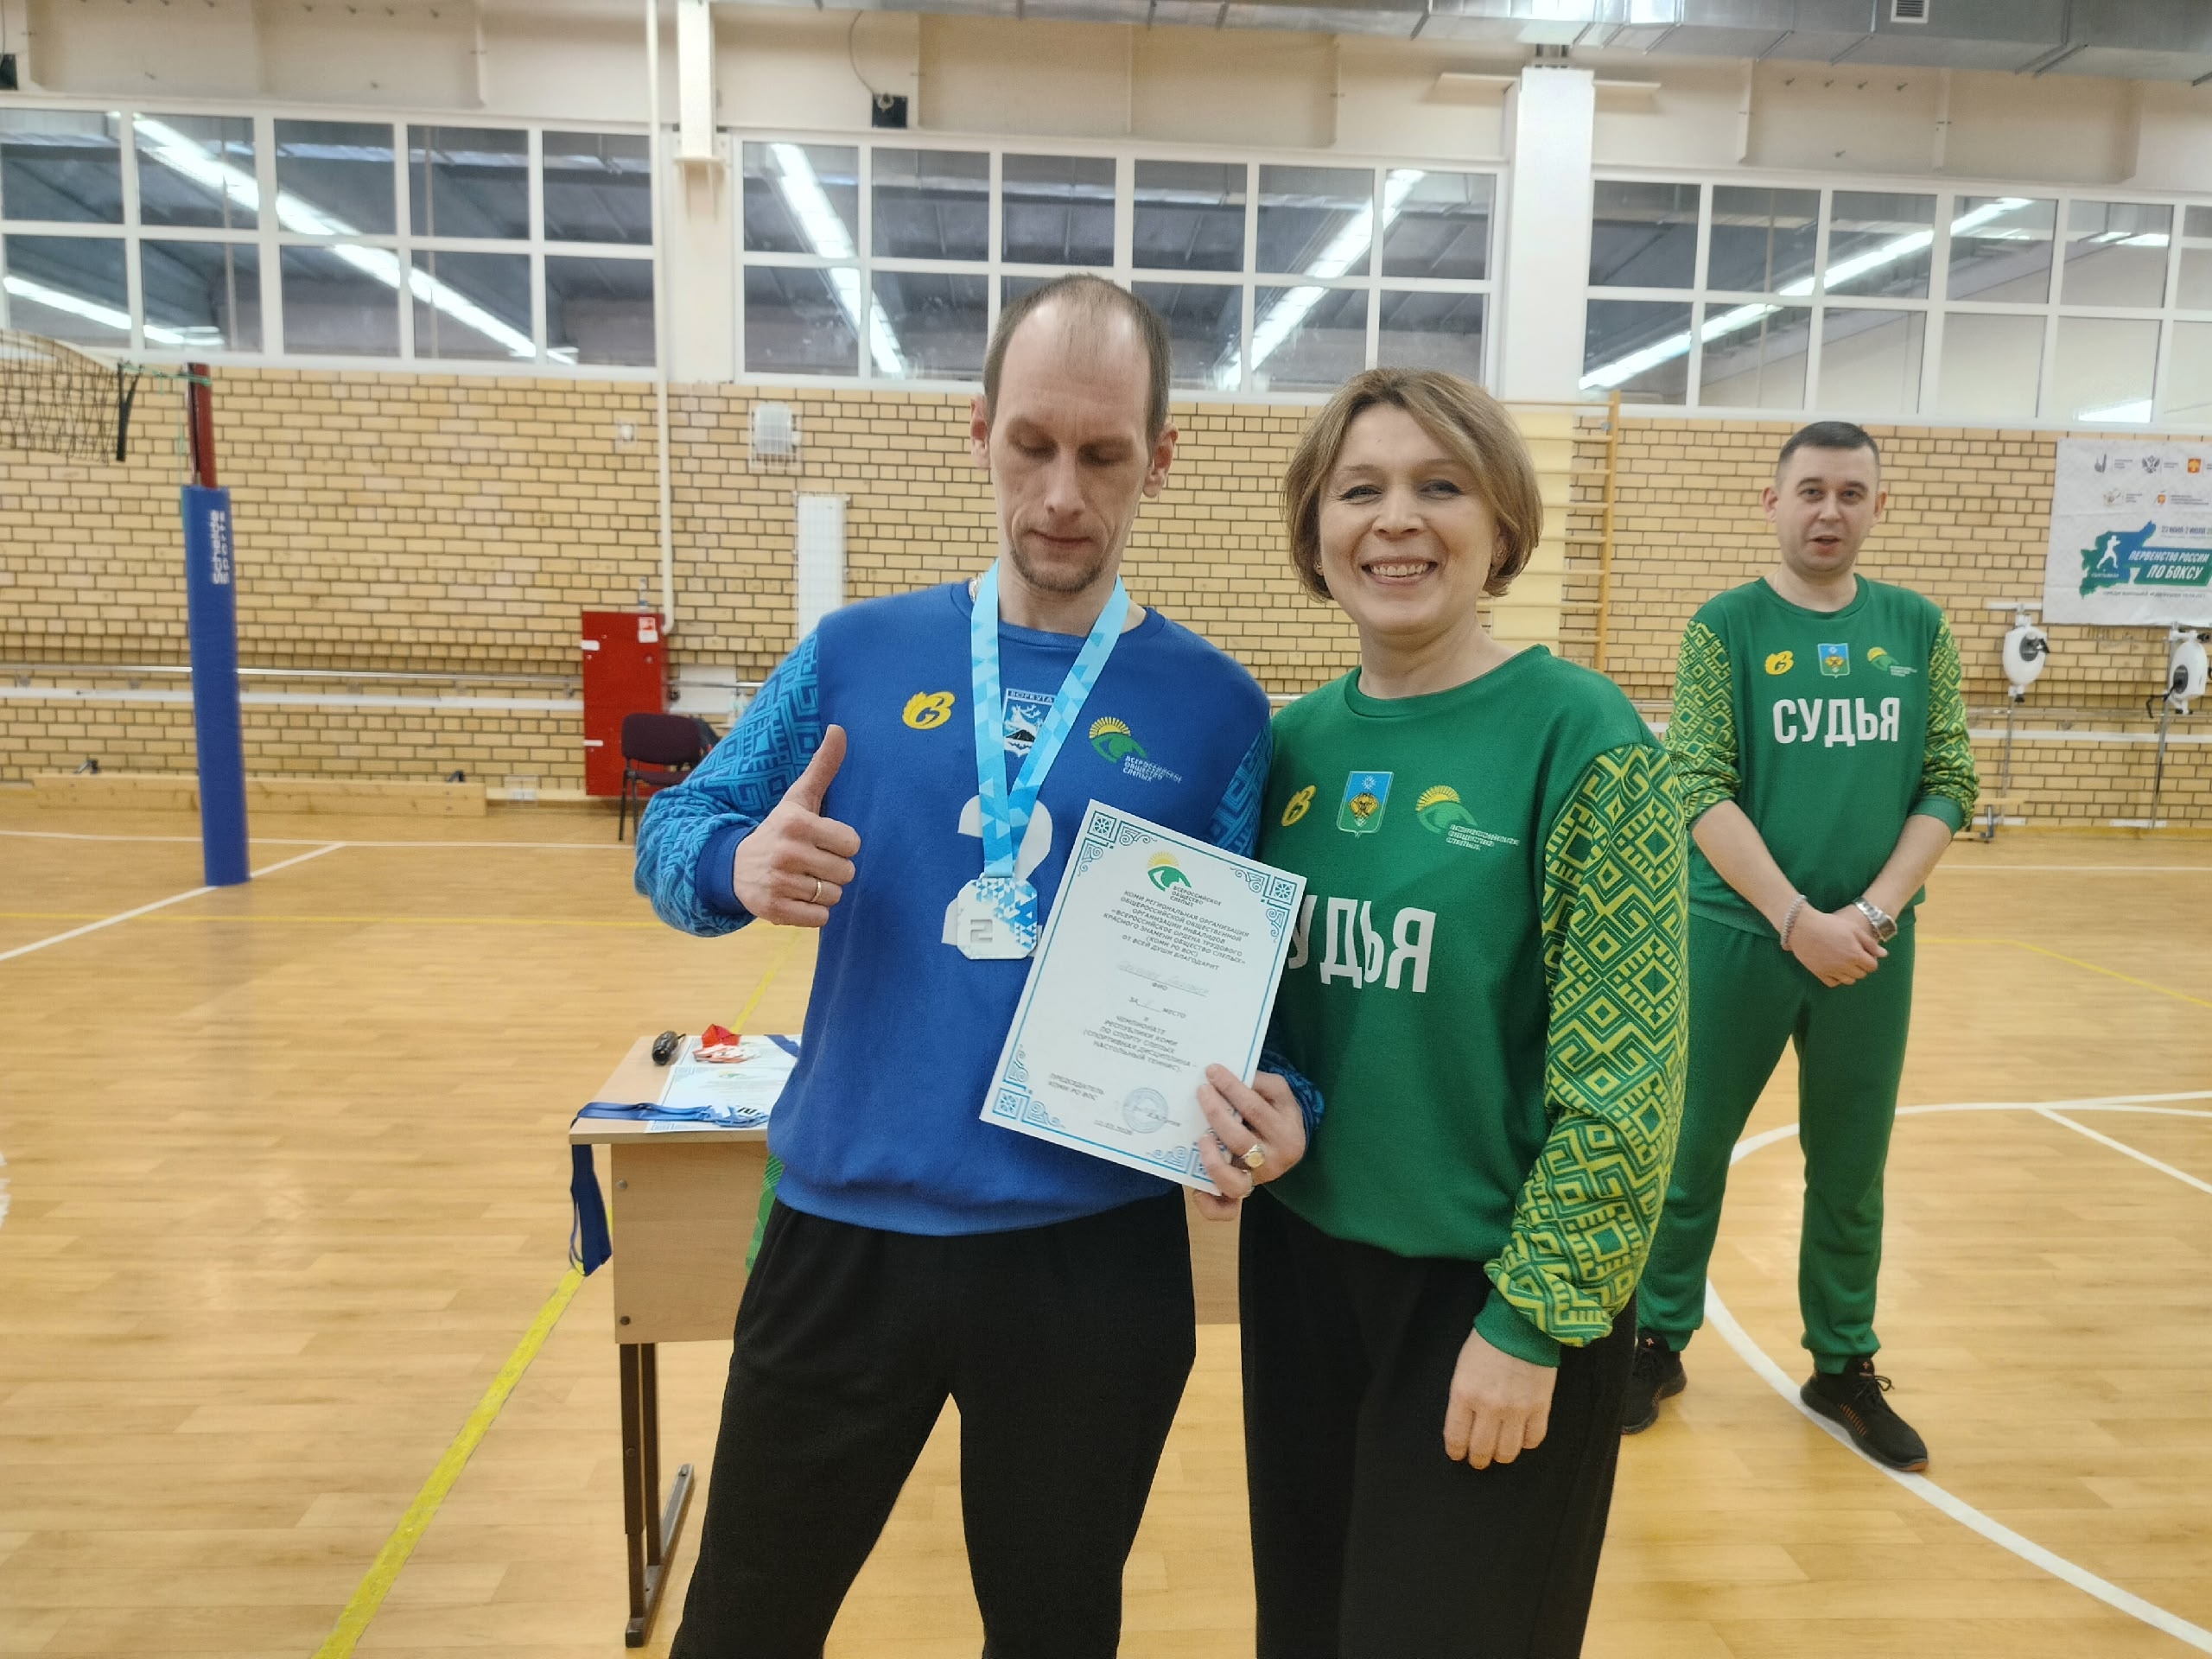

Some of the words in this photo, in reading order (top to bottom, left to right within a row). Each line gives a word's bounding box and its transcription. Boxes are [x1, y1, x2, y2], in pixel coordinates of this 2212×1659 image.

[2127, 550, 2177, 562] ПЕРВЕНСТВО
[2177, 551, 2210, 563] РОССИИ
[2146, 564, 2164, 578] ПО
[2164, 565, 2203, 580] БОКСУ
[1010, 690, 1053, 703] ВОРКУТА
[1772, 696, 1900, 747] СУДЬЯ
[1172, 890, 1203, 905] ОБЩЕСТВО
[1173, 885, 1221, 906] ВСЕРОССИЙСКОЕ
[1120, 895, 1185, 923] ОБЩЕРОССИЙСКОЙ
[1185, 918, 1241, 943] ОБЩЕСТВЕННОЙ
[1124, 890, 1143, 901] КОМИ
[1145, 898, 1198, 920] РЕГИОНАЛЬНАЯ
[1199, 917, 1249, 938] ОРГАНИЗАЦИЯ
[1132, 908, 1181, 929] ОРГАНИЗАЦИИ
[1183, 925, 1224, 944] ИНВАЛИДОВ
[969, 918, 994, 944] 2
[1103, 912, 1138, 929] КРАСНОГО
[1139, 925, 1173, 940] ЗНАМЕНИ
[1173, 937, 1211, 954] ОБЩЕСТВО
[1173, 930, 1200, 944] ОРДЕНА
[1203, 938, 1242, 957] ТРУДОВОГО
[1287, 894, 1437, 993] УДЬЯ
[1133, 937, 1150, 947] ВСЕЙ
[1151, 944, 1173, 956] ДУШИ
[1173, 950, 1218, 971] БЛАГОДАРИТ
[1146, 935, 1169, 947] (КОМИ
[1181, 947, 1198, 957] ВОС)
[1152, 982, 1167, 991] ФИО
[1162, 1007, 1185, 1019] МЕСТО
